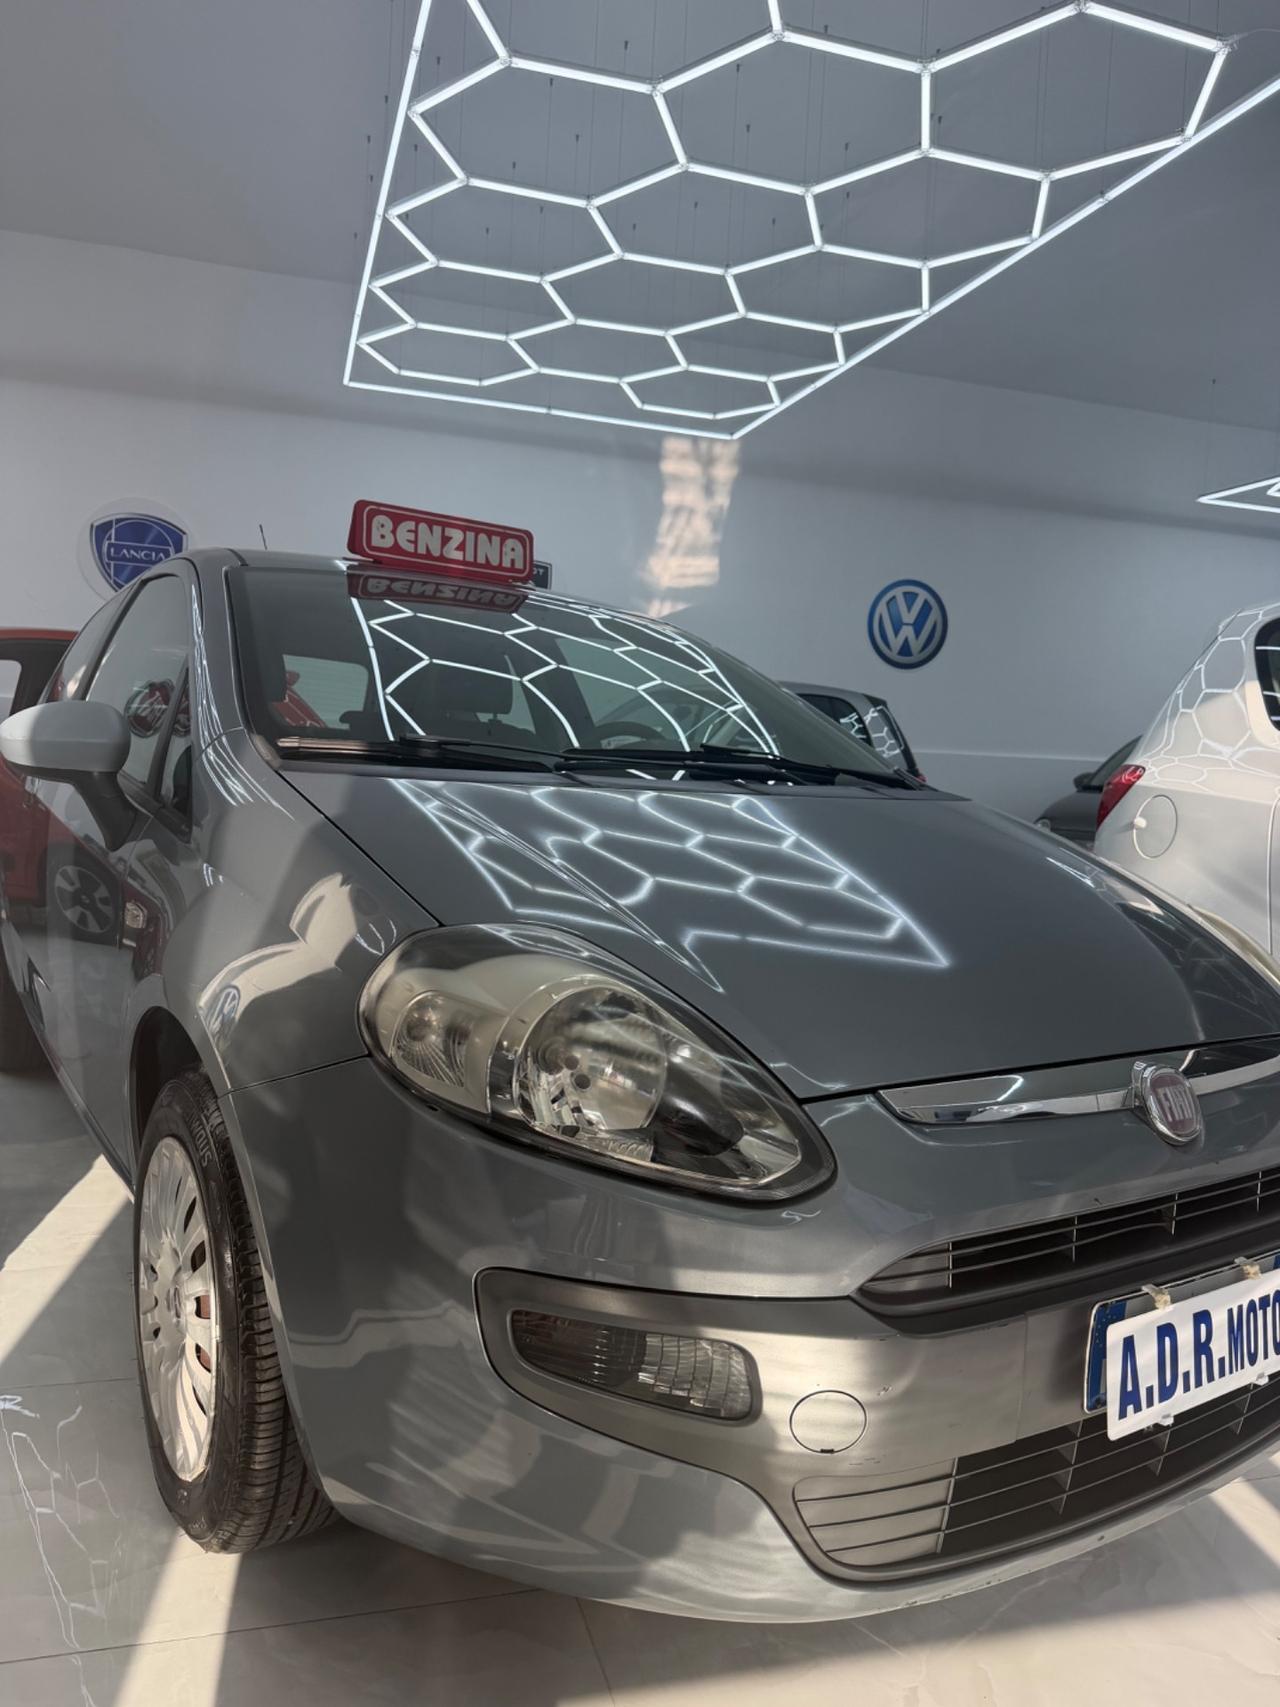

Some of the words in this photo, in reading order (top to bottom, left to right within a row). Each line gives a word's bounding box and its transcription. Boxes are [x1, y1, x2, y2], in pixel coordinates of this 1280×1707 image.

[110, 547, 166, 561] LANCIA
[371, 514, 524, 569] BENZINA
[870, 582, 945, 666] VW
[1158, 1084, 1194, 1122] FIAT
